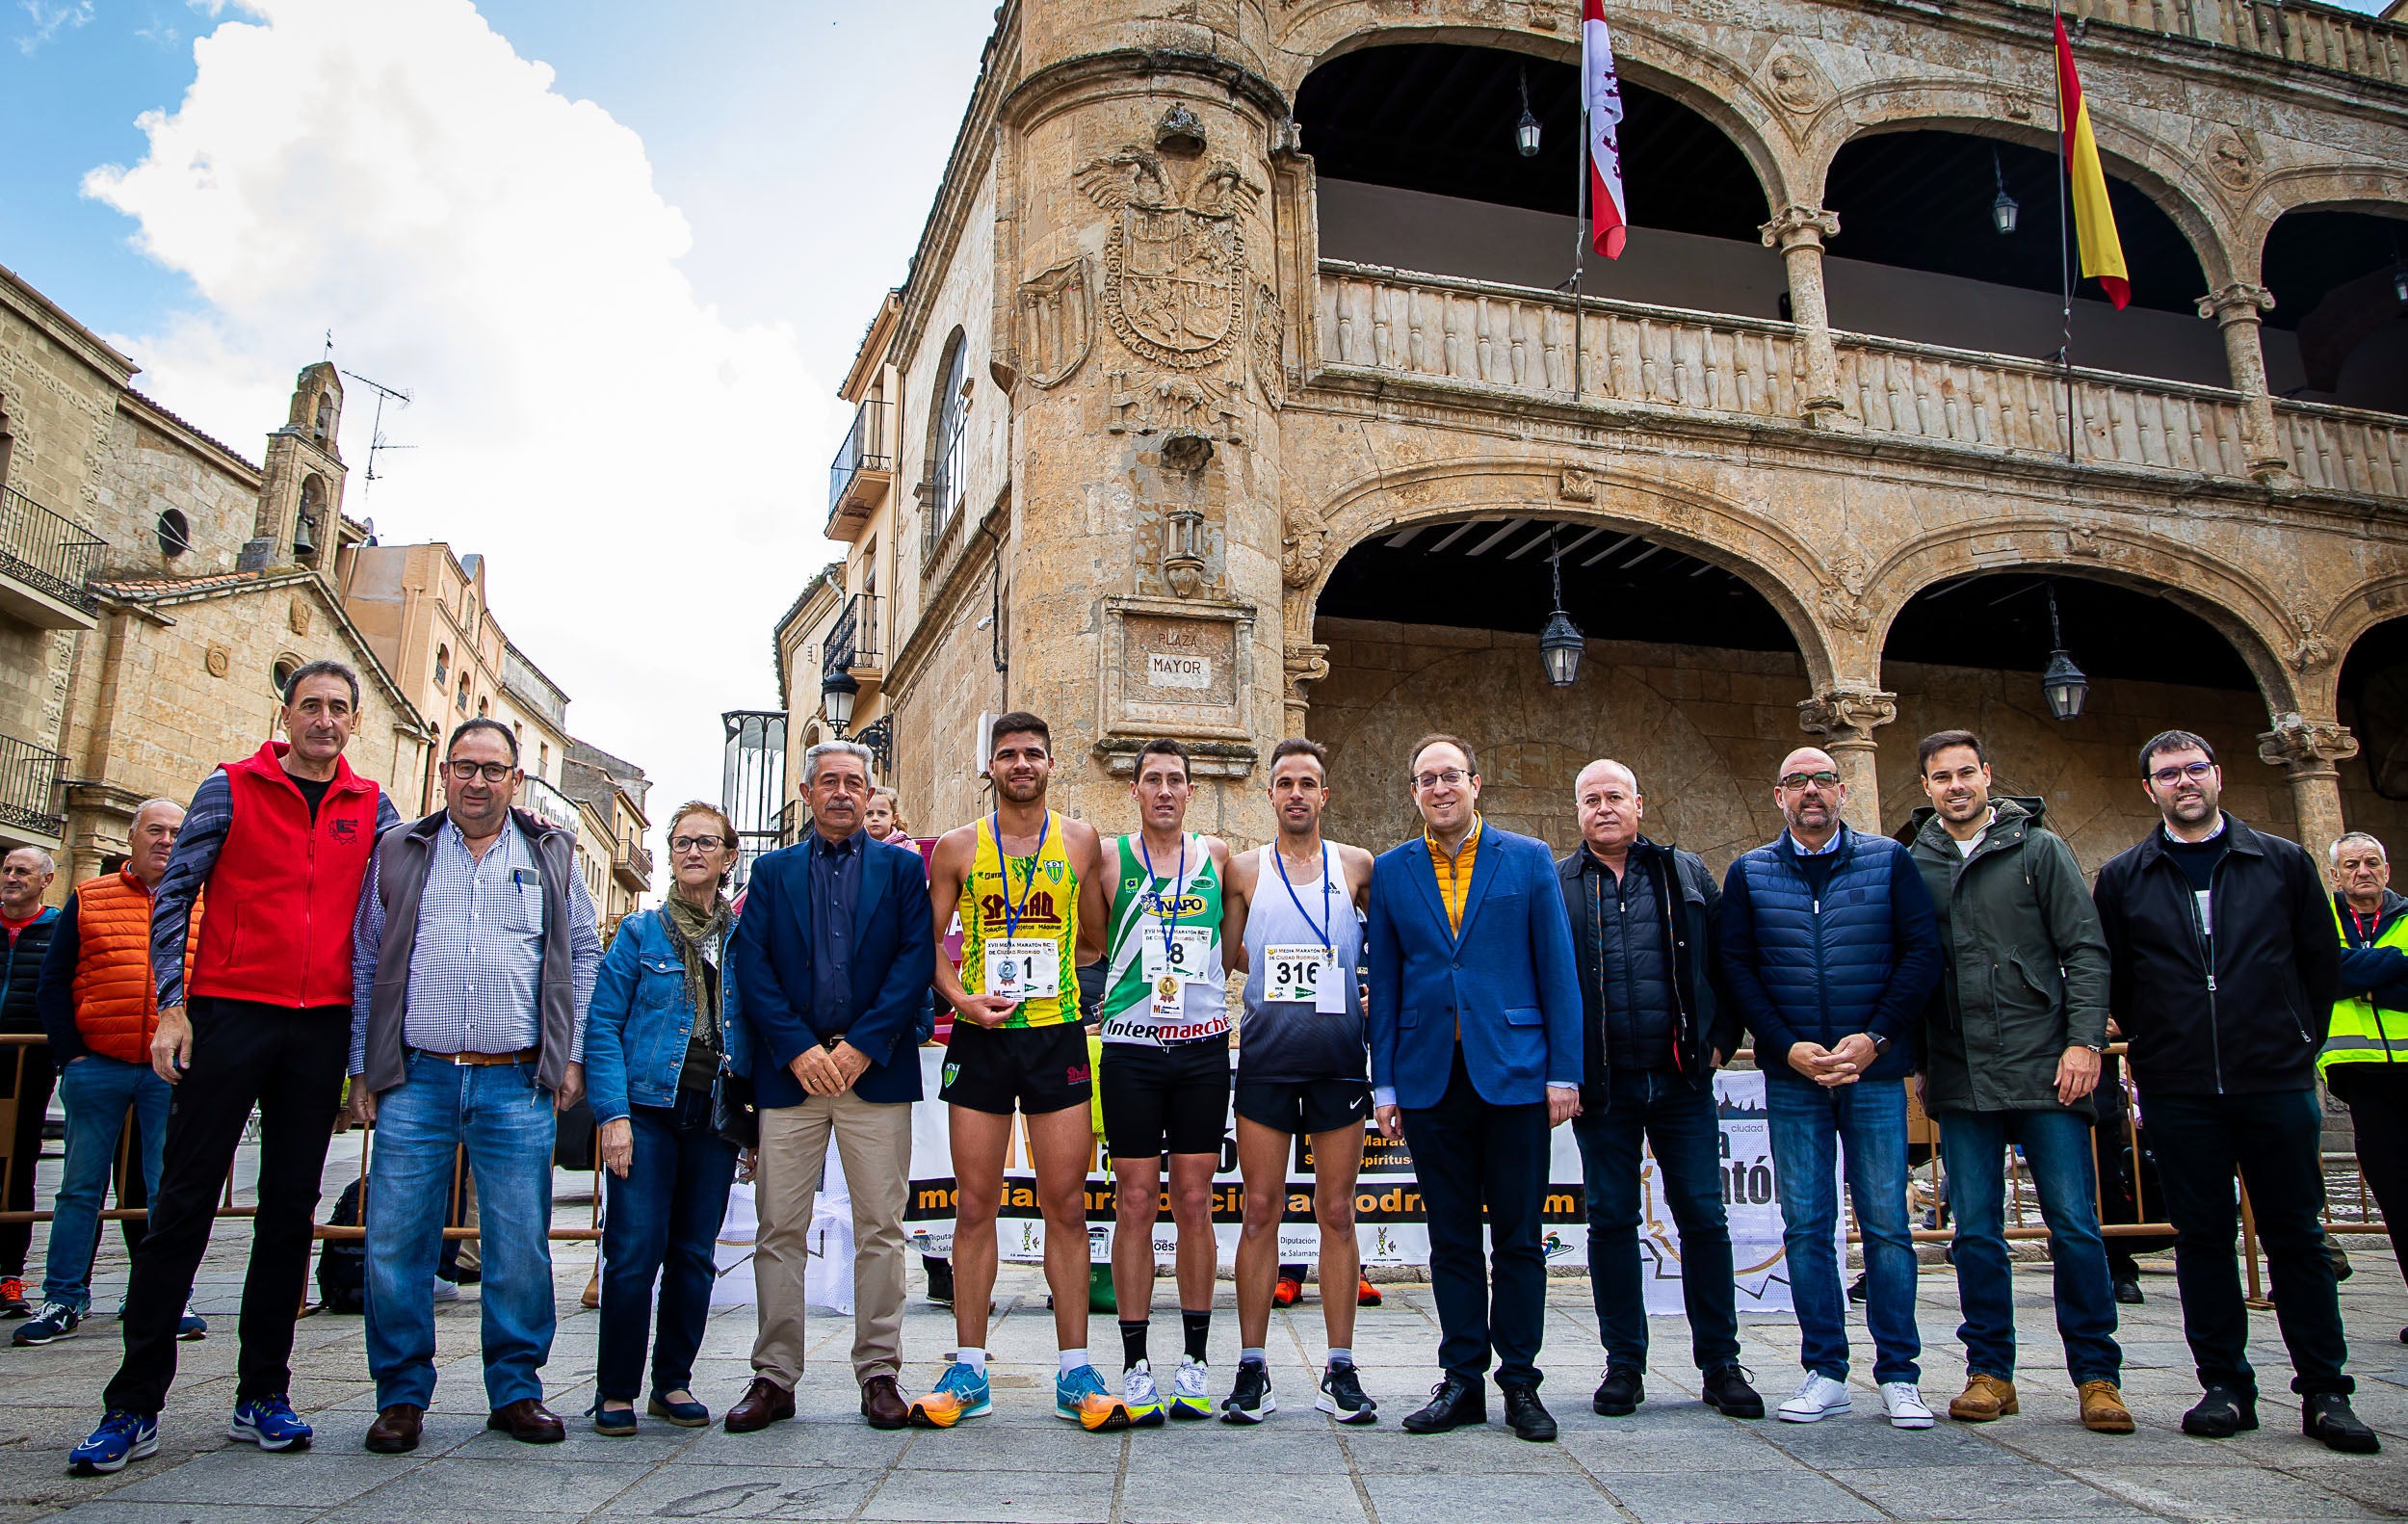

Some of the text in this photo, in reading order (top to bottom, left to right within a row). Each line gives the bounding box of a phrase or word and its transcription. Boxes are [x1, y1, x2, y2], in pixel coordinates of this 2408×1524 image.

[1158, 634, 1196, 647] PLAZA
[1153, 658, 1201, 674] MAYOR
[1169, 942, 1185, 965] 8
[1004, 964, 1011, 974] 2
[1023, 956, 1033, 980] 1
[1276, 961, 1321, 985] 316
[1165, 981, 1170, 990] 1
[1731, 1124, 1764, 1133] ciudad
[1364, 1135, 1407, 1146] Marat
[1280, 1236, 1317, 1246] Diputación
